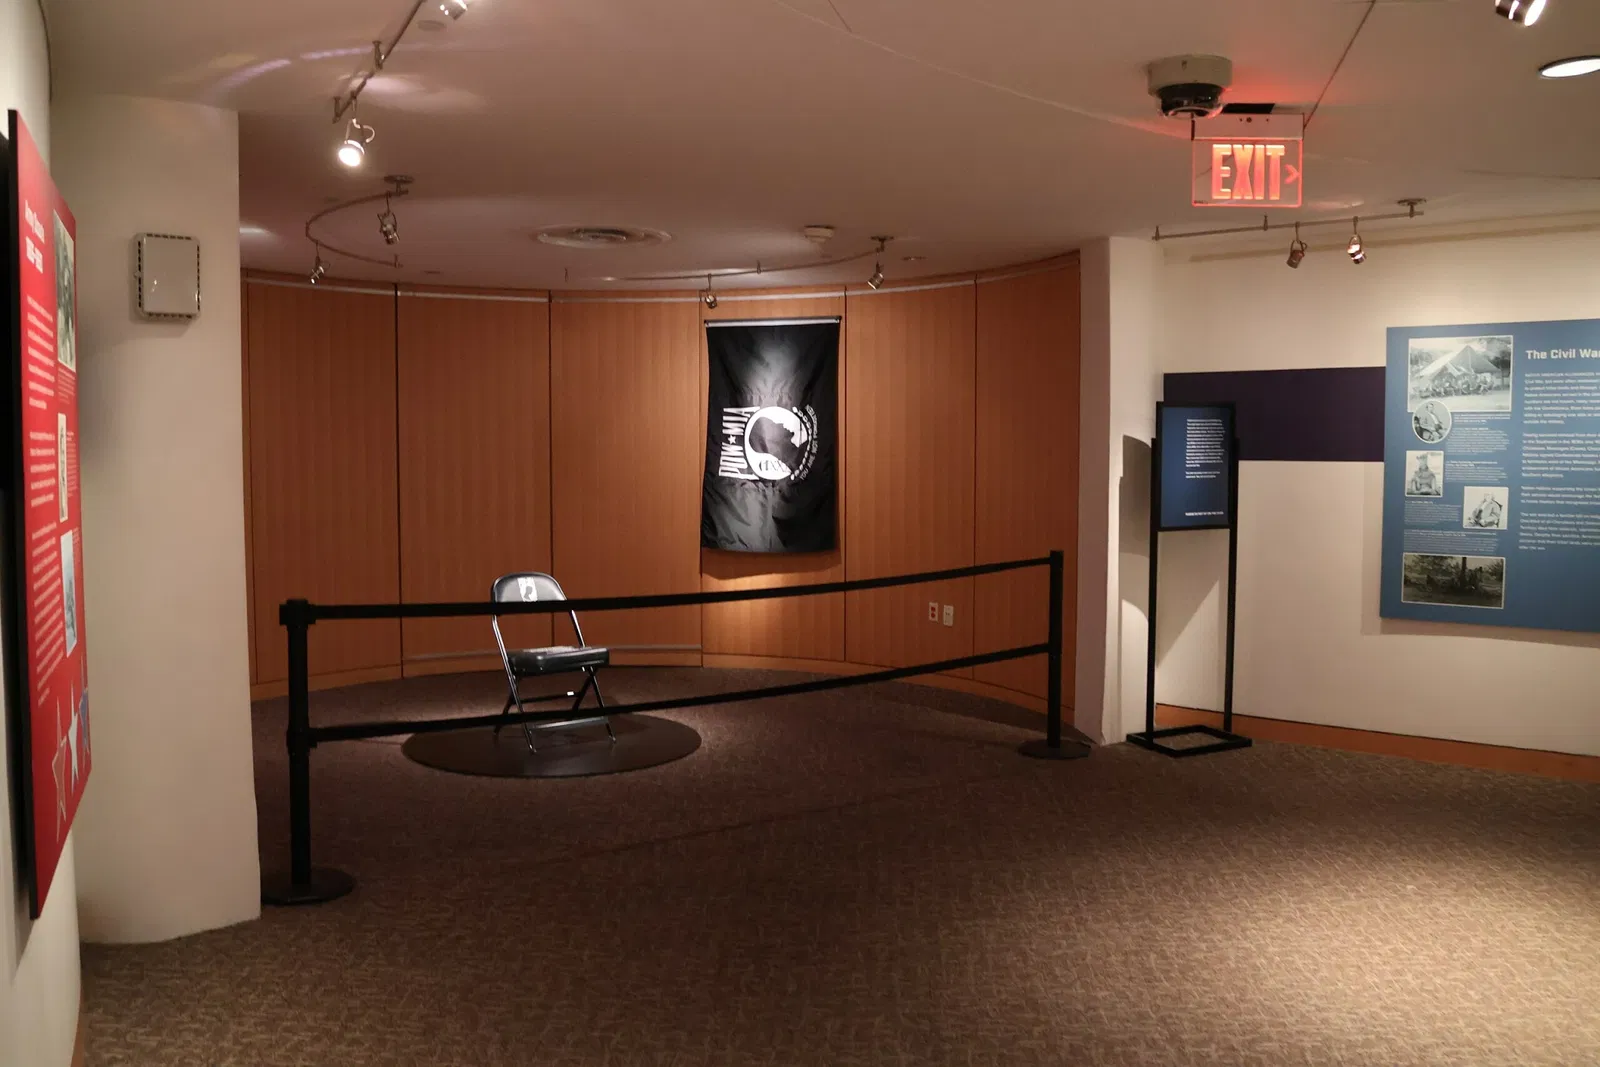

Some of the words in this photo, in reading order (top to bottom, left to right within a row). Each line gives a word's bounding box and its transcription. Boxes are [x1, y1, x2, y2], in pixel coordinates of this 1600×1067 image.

[1212, 144, 1285, 200] EXIT
[1525, 349, 1547, 360] The
[1550, 348, 1576, 359] Civil
[722, 406, 761, 435] MIA
[719, 441, 760, 481] POW
[799, 467, 809, 480] YOU
